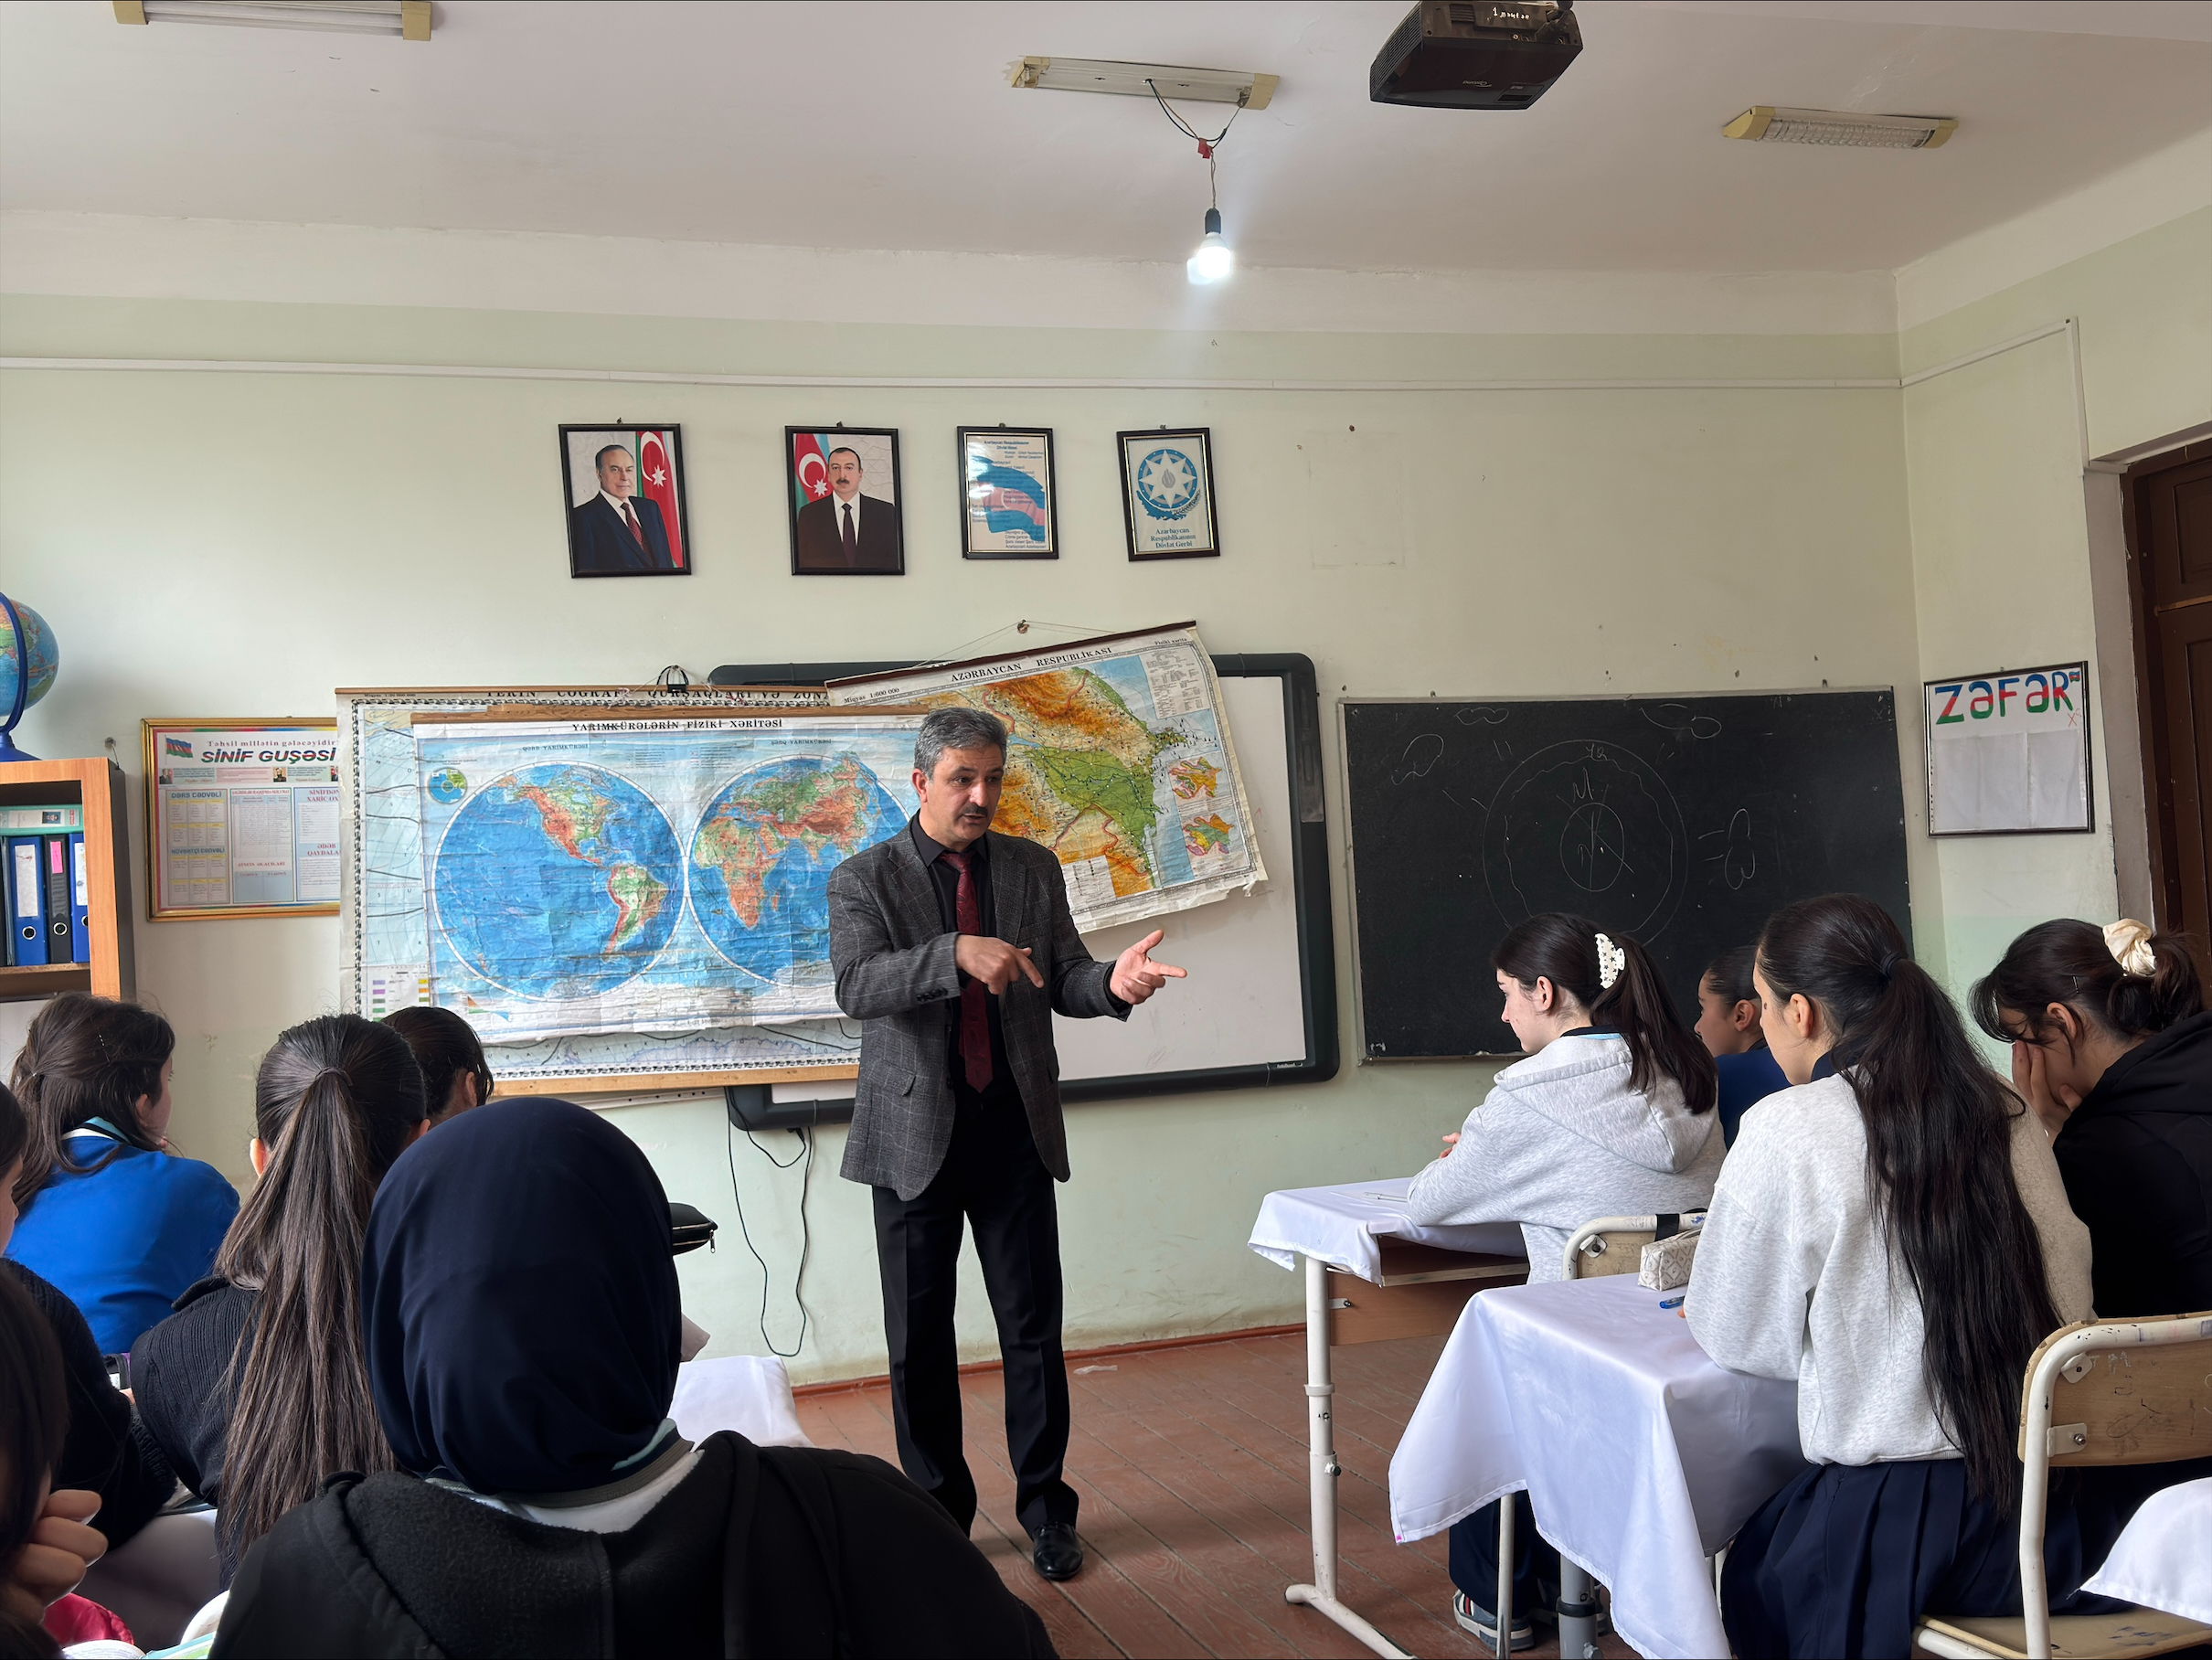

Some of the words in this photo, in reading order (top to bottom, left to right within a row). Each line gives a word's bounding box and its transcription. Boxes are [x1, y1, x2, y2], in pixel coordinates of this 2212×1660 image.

[951, 663, 1022, 682] AZƏRBAYCAN
[1036, 647, 1112, 666] RESPUBLİKASI
[844, 695, 867, 704] Miqyas
[869, 690, 887, 698] 1:600
[888, 687, 899, 696] 000
[1934, 670, 2074, 725] ZƏFƏR
[572, 720, 679, 731] YARIMKÜRƏLƏRİN
[686, 719, 723, 729] FİZİKİ
[729, 718, 783, 729] XƏRİTƏSİ
[201, 748, 254, 763] SİNİF
[258, 747, 337, 765] GUŞƏSİ
